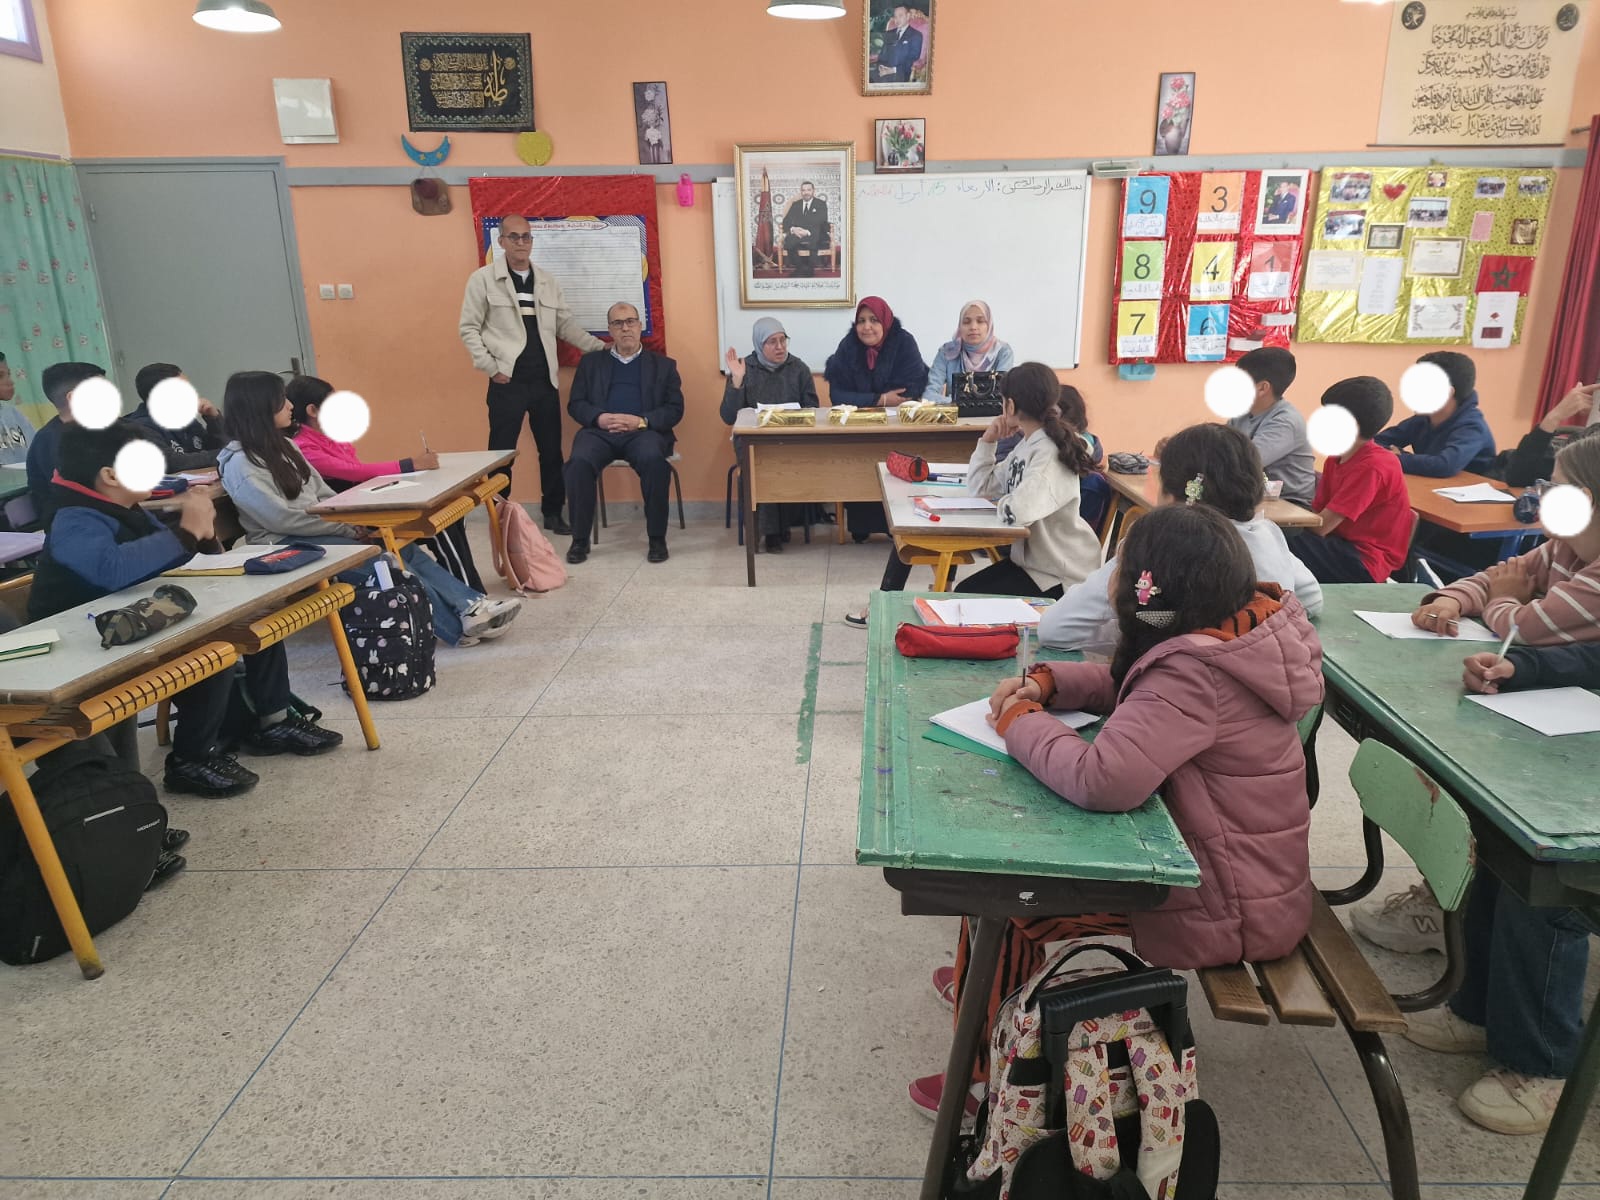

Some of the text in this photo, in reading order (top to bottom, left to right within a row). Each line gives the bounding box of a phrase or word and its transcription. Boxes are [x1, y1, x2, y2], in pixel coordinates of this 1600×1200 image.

[1140, 189, 1157, 214] 9
[1211, 186, 1228, 213] 3
[1134, 253, 1151, 280] 8
[1203, 254, 1220, 281] 4
[1264, 255, 1275, 272] 1
[1130, 313, 1146, 335] 7
[1200, 316, 1216, 335] 6
